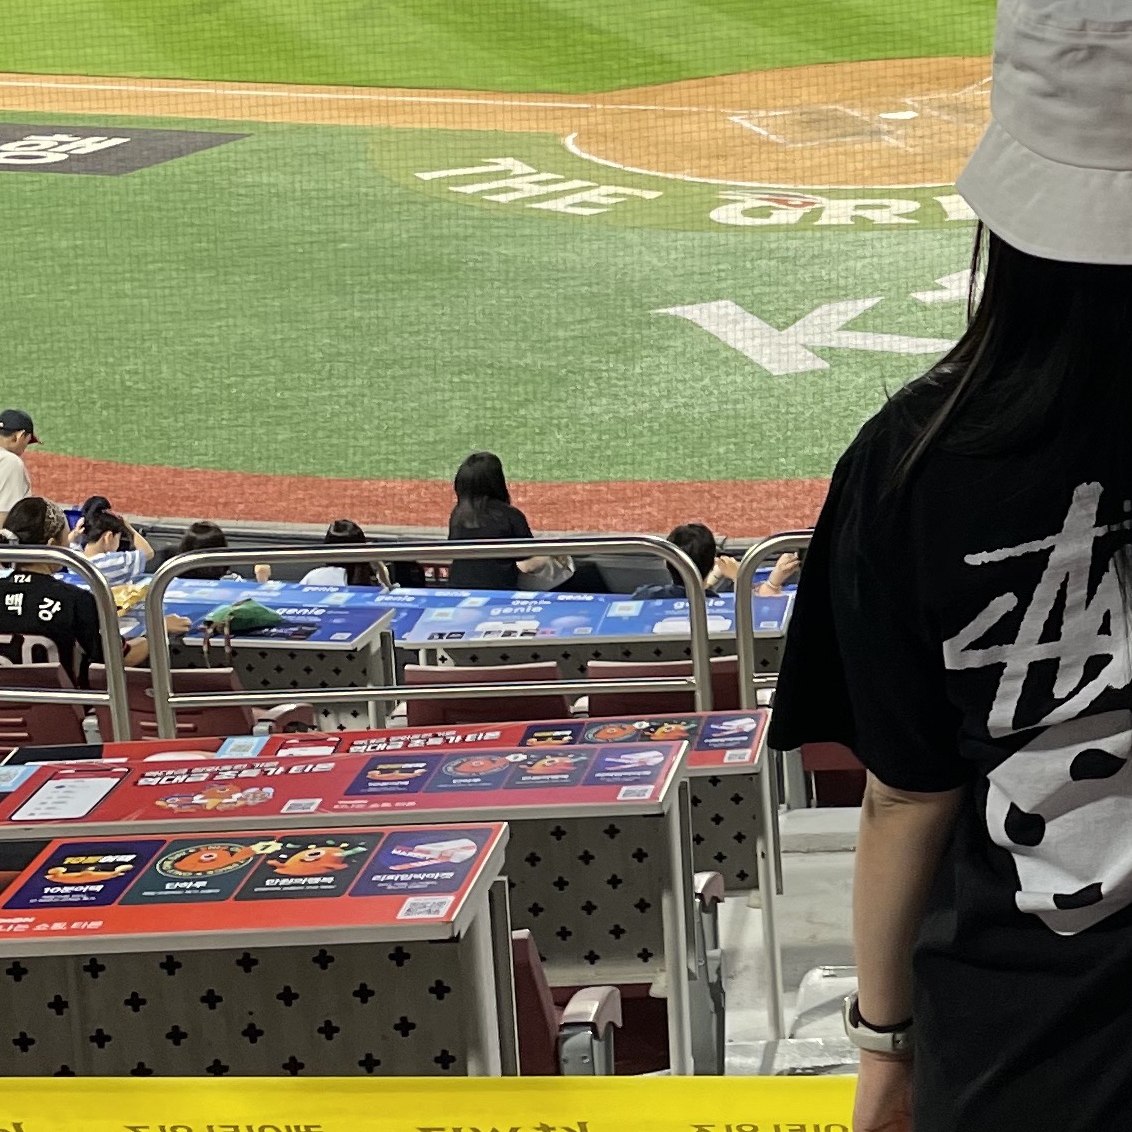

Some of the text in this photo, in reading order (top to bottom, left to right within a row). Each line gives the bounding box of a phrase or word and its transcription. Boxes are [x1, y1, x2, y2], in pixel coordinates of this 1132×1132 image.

[415, 158, 664, 216] THE
[557, 593, 594, 602] genie
[490, 604, 543, 616] genie
[673, 599, 726, 610] gie
[276, 606, 326, 617] genie
